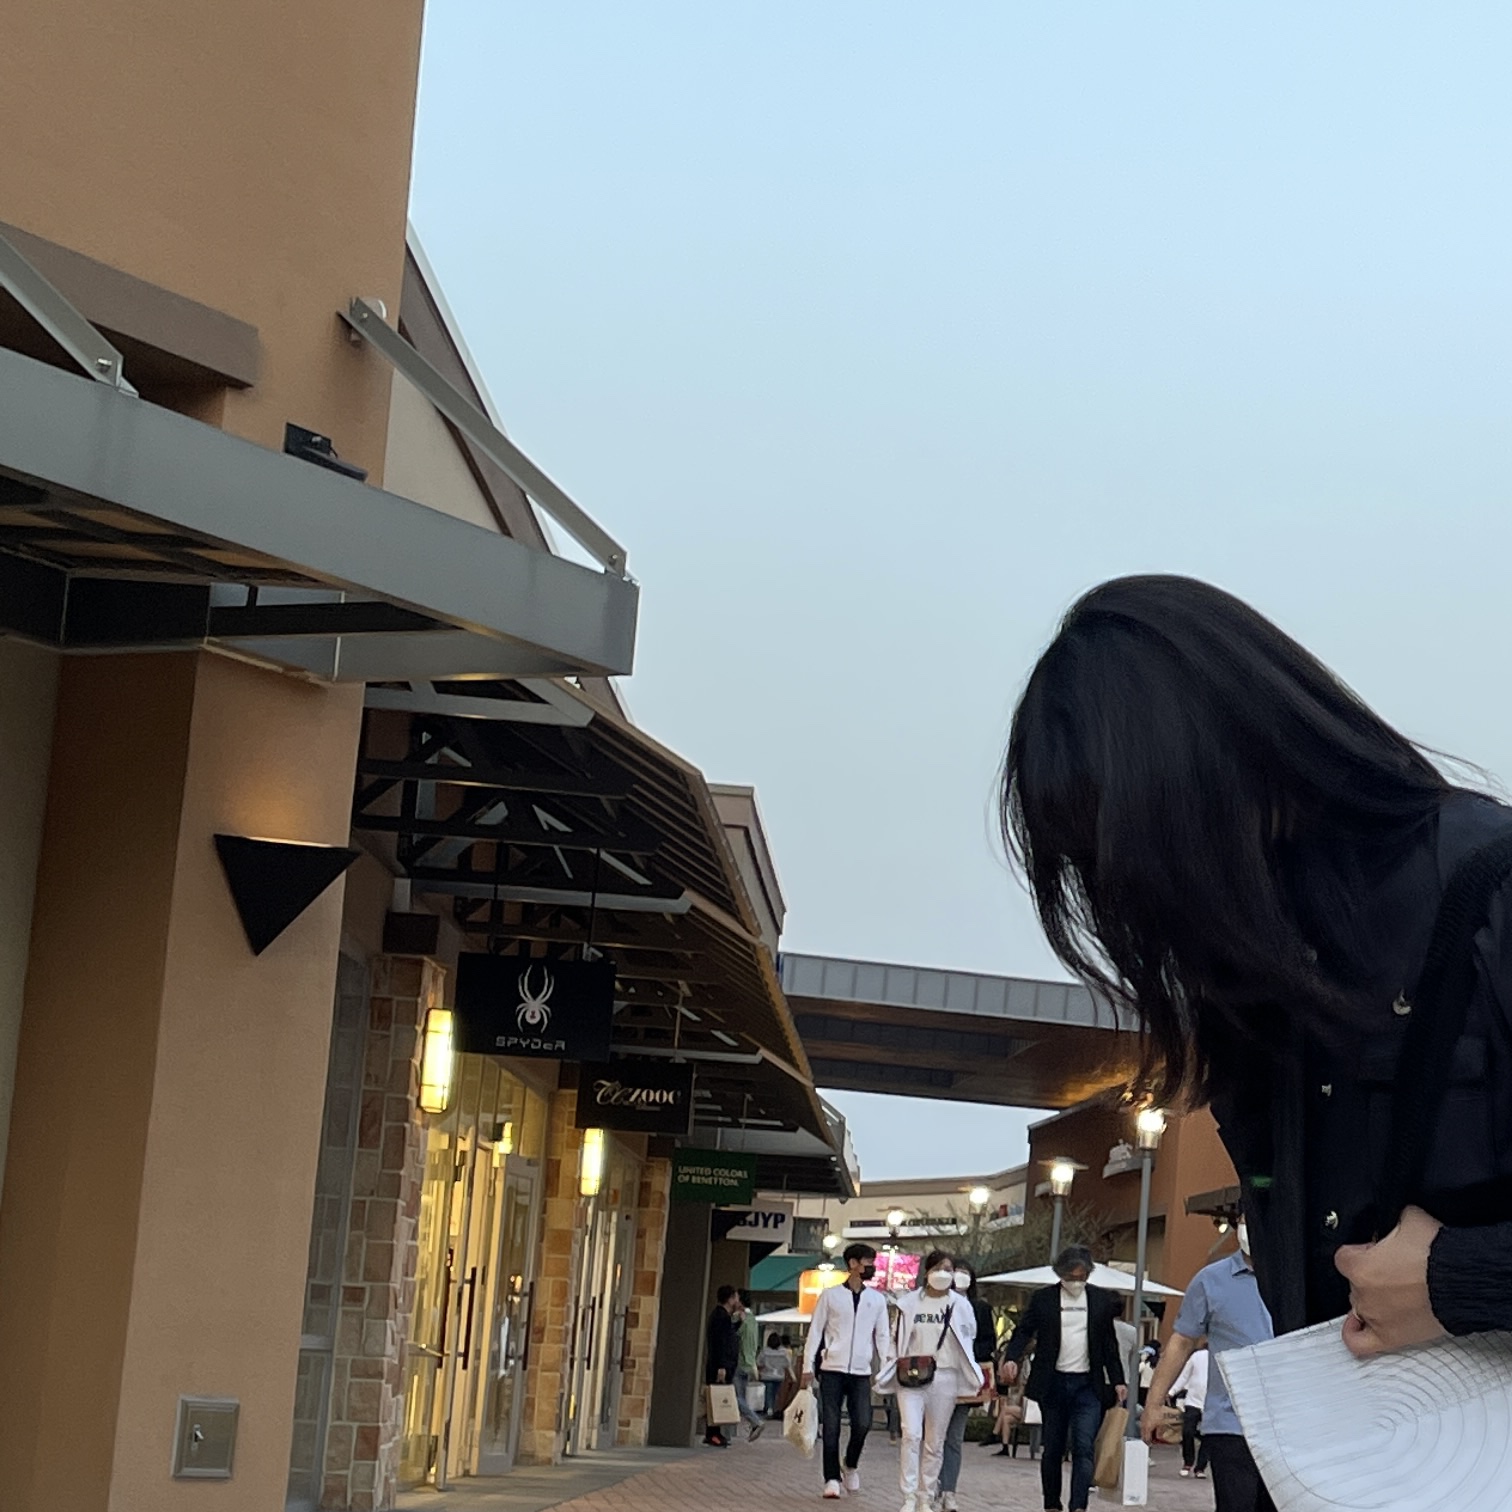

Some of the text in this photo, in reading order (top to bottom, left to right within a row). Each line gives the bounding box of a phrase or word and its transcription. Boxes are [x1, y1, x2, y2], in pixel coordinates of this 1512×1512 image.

[495, 1035, 566, 1051] SPYDER
[677, 1174, 690, 1183] OF
[678, 1165, 749, 1179] UNITED COLORS
